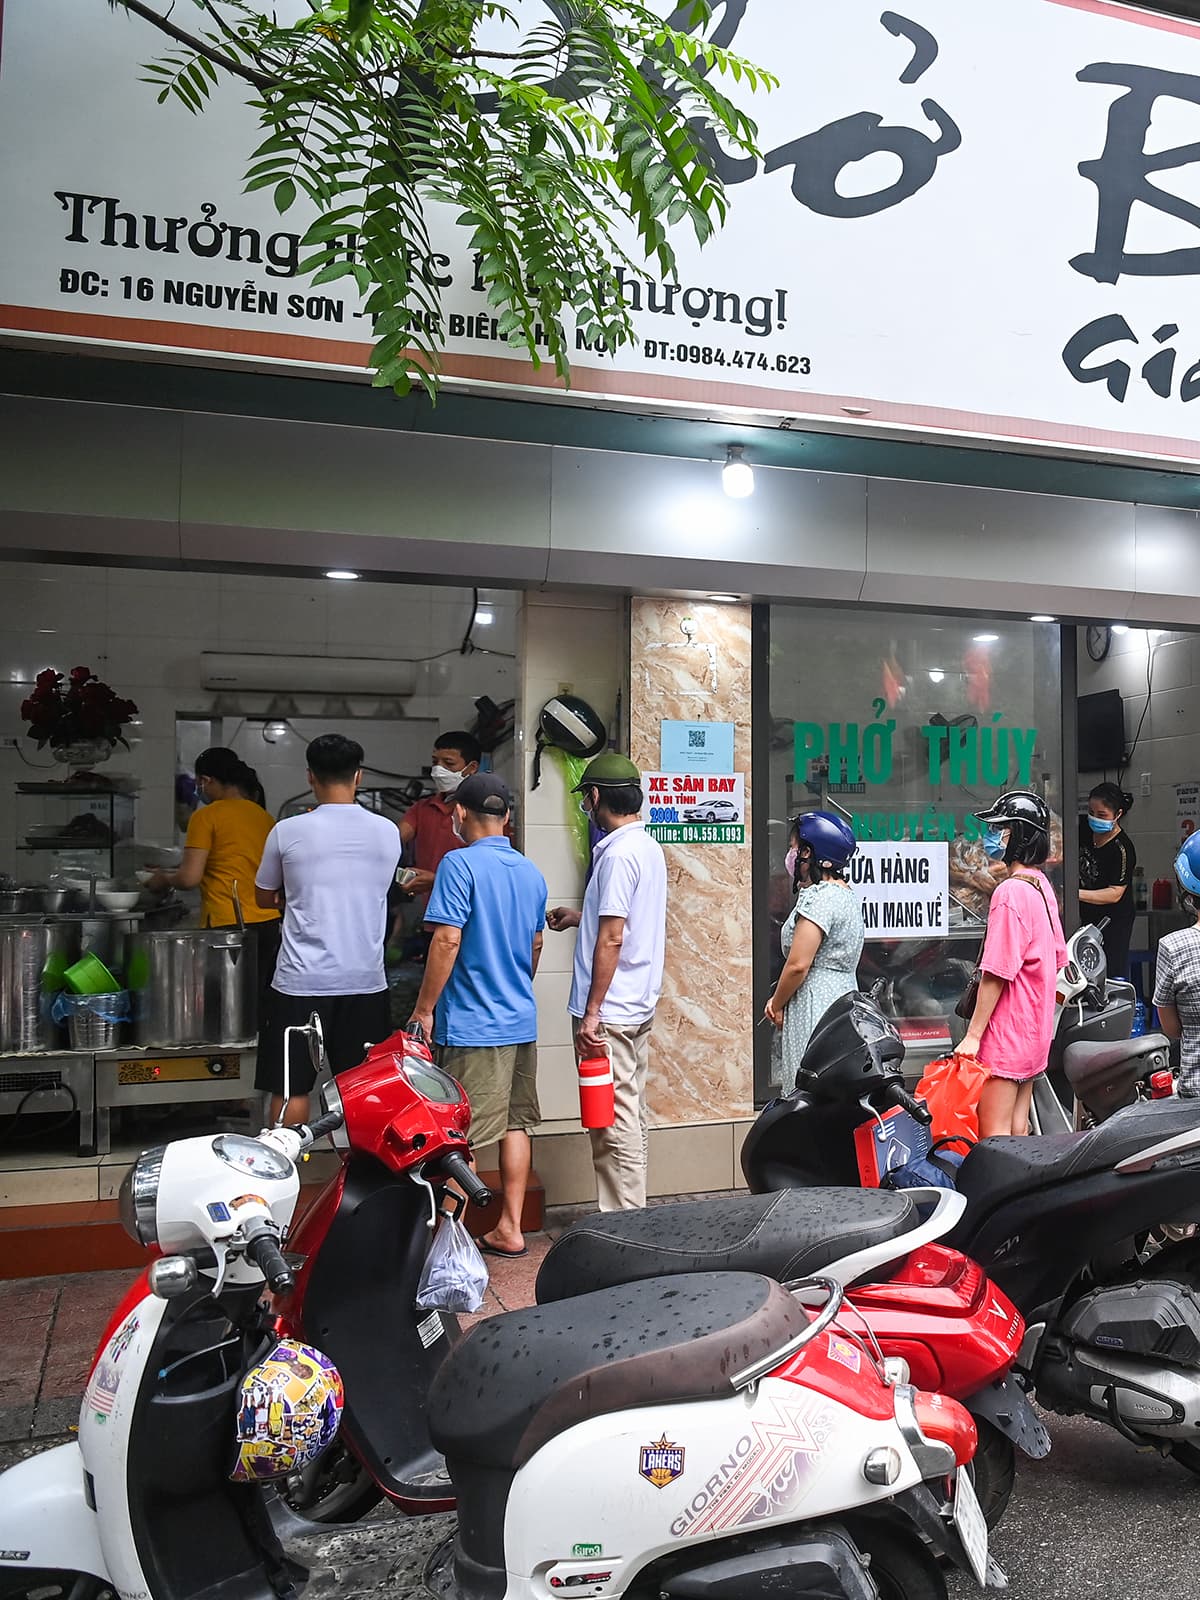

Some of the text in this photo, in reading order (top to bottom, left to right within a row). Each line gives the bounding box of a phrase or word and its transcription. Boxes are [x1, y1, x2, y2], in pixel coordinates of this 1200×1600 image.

[54, 191, 302, 278] Thưởng
[59, 268, 109, 297] ĐC:
[120, 275, 154, 301] 16
[164, 280, 278, 316] NGUYỄN
[287, 294, 345, 323] SƠN
[644, 339, 812, 375] ĐT:0984.474.623
[793, 697, 897, 785] PHỞ
[920, 712, 1039, 787] THÚY
[648, 774, 737, 793] XE SÂN BAY
[648, 793, 660, 805] VÀ
[663, 795, 673, 805] ĐI
[649, 806, 680, 823] 200k
[683, 827, 742, 842] 094.558.1993
[881, 852, 930, 884] HÀNG
[861, 891, 943, 929] ÁN MANG VỀ
[642, 1453, 682, 1471] LAKERS
[669, 1435, 752, 1536] GIORNO
